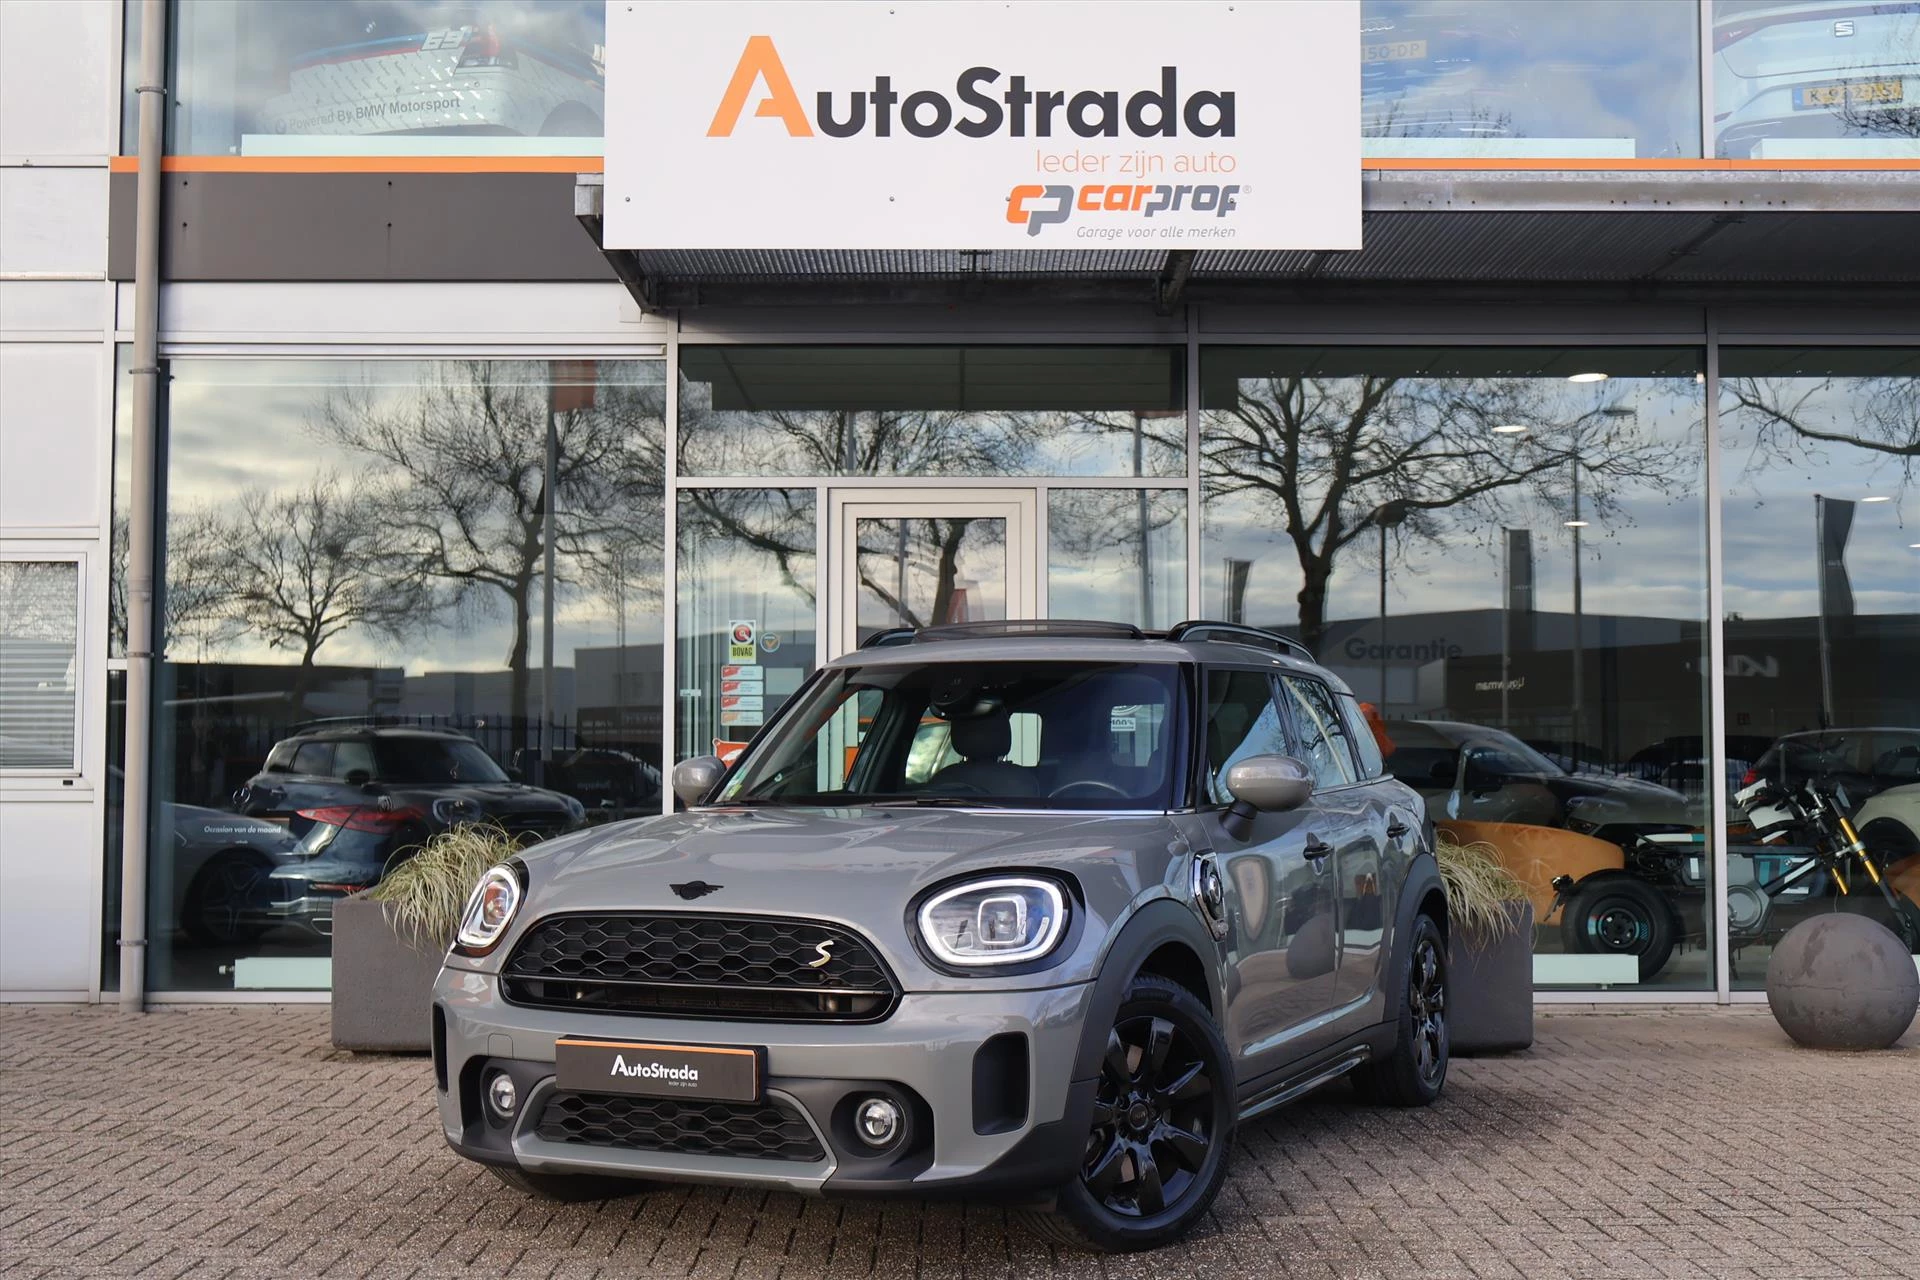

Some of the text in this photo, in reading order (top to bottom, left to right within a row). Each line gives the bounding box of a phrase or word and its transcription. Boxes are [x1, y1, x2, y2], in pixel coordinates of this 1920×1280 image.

[706, 35, 1236, 138] AutoStrada
[289, 98, 461, 129] Powered By BMW Motorsport
[1036, 150, 1236, 178] Ieder zijn auto
[1077, 185, 1240, 218] carprof
[1077, 226, 1236, 240] Garage voor alle merken
[732, 647, 753, 657] BOVAG
[1344, 637, 1463, 660] Garantie
[611, 1054, 698, 1080] AutoStrada
